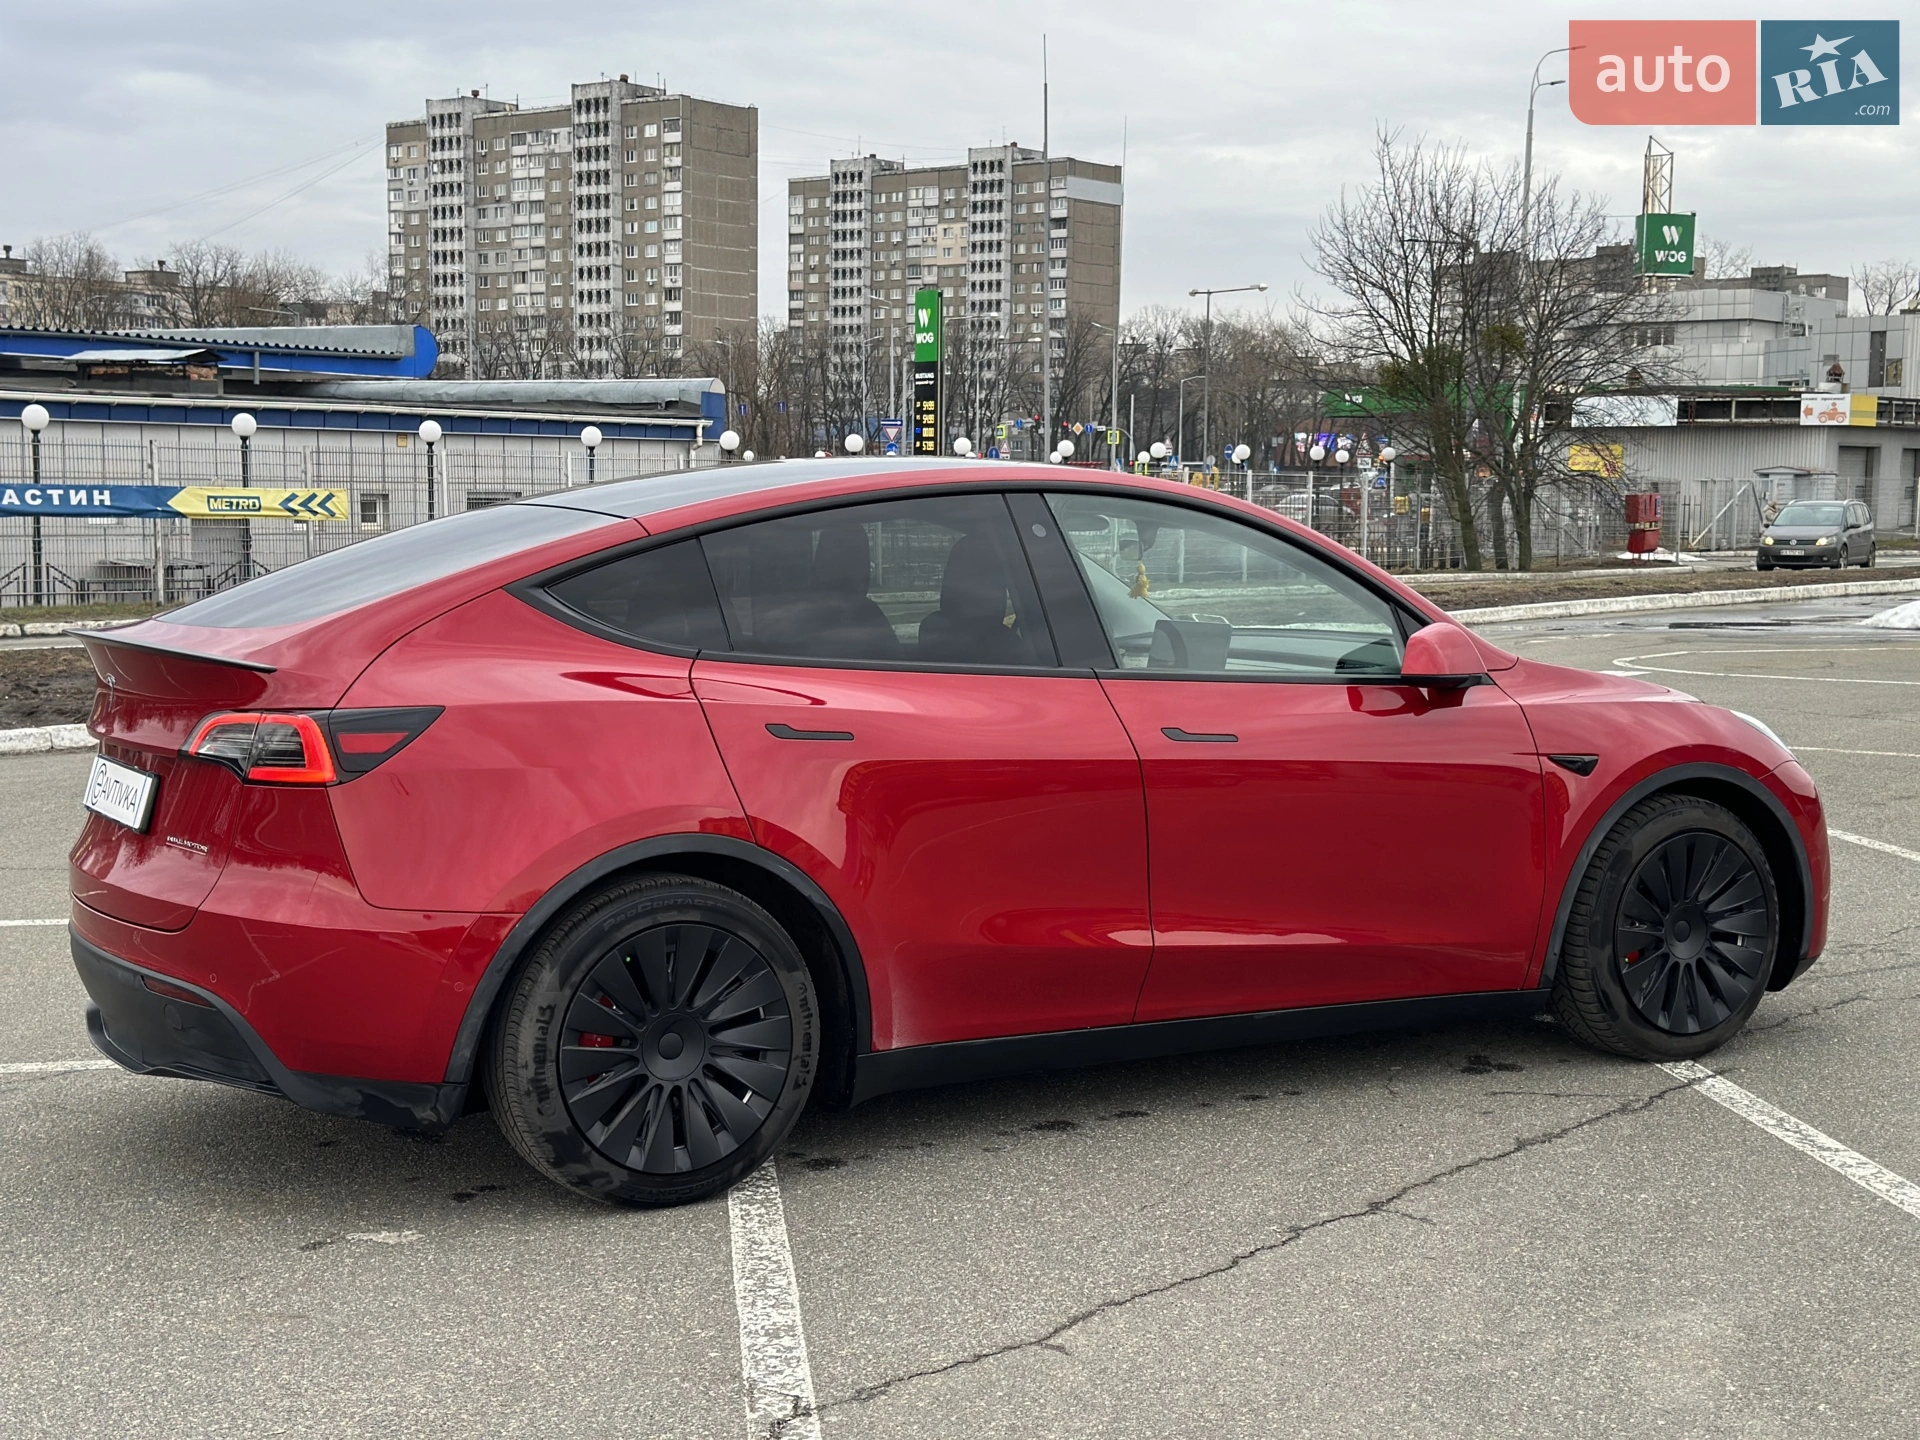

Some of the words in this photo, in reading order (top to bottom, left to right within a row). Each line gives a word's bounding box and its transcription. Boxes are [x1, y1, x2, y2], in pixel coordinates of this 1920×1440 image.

[1654, 250, 1687, 263] WOG
[915, 331, 935, 344] WOG
[1, 488, 112, 506] АСТИН
[209, 497, 260, 510] METRO
